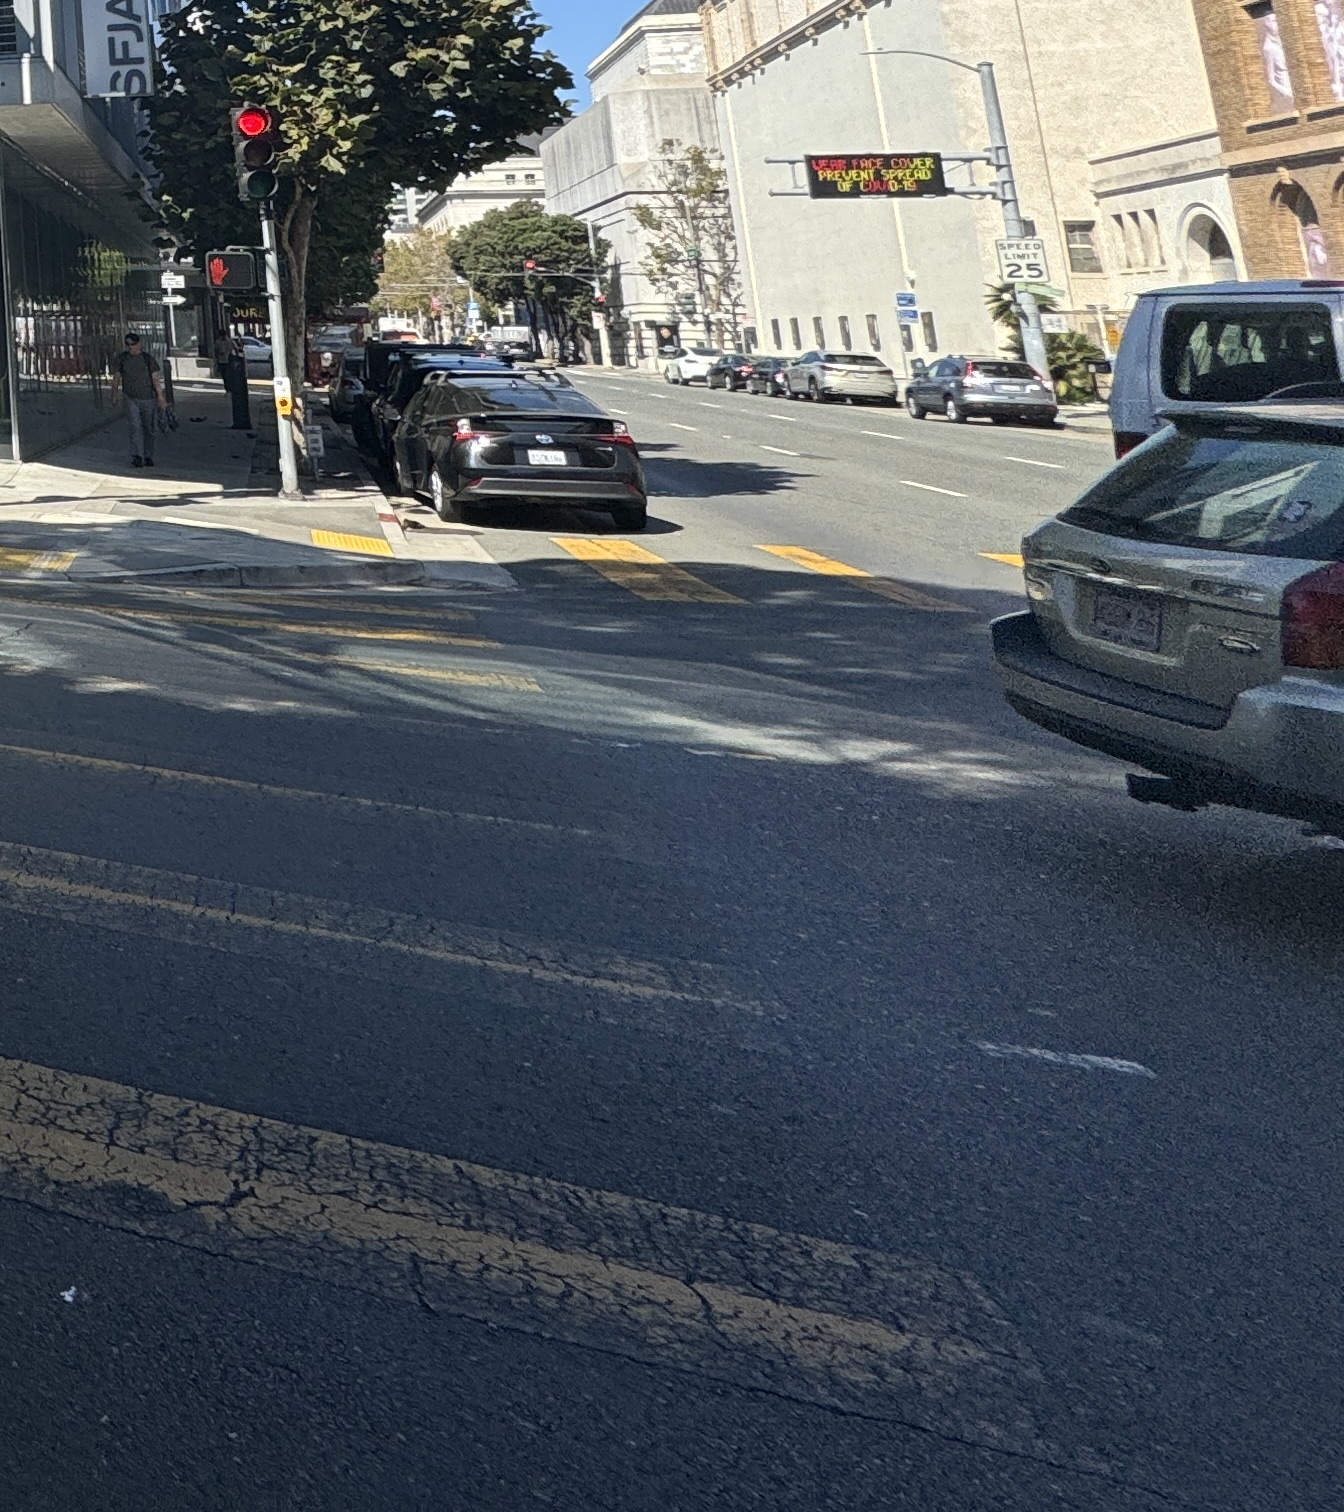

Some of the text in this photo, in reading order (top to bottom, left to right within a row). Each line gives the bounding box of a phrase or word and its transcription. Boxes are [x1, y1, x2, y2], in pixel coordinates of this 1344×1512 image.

[812, 157, 935, 170] WEAR FACE COVER
[819, 168, 932, 181] PREVENT SPREAD
[837, 179, 918, 192] OF COVID-19
[998, 242, 1042, 251] SPEED
[1004, 252, 1039, 261] LIMIT
[1004, 263, 1044, 279] 25
